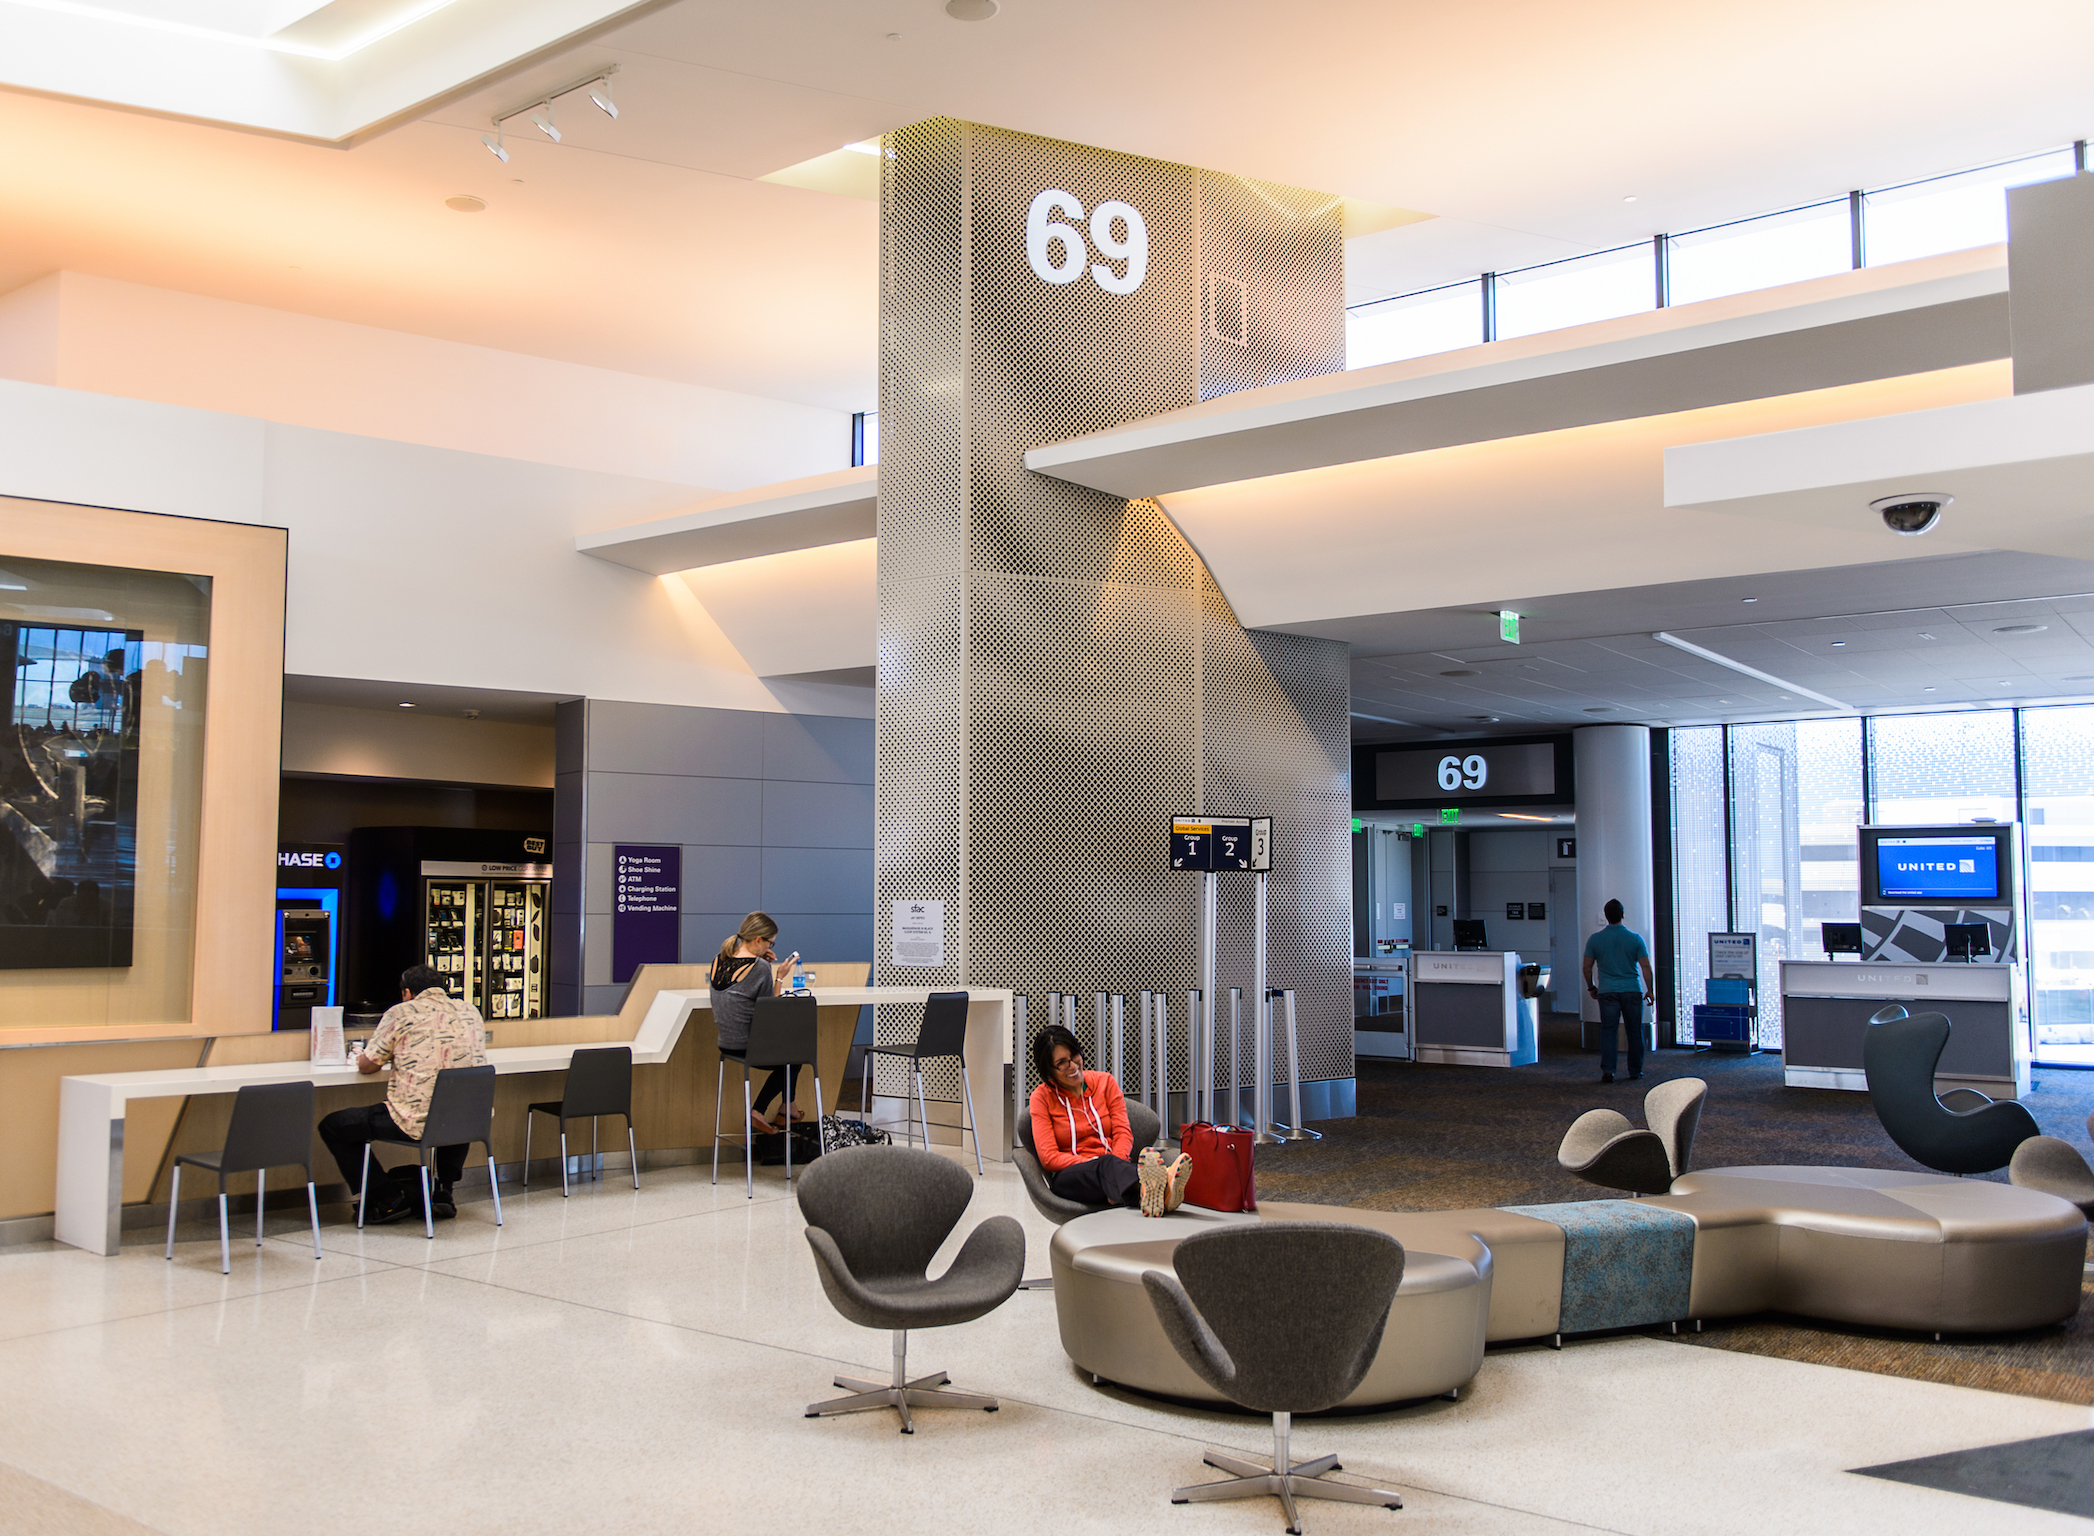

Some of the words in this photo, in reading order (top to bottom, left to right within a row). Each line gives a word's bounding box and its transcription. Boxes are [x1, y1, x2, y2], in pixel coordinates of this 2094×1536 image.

[1026, 189, 1148, 295] 69
[1437, 754, 1487, 791] 69
[1441, 808, 1459, 824] EXIT
[1188, 841, 1197, 856] 1
[1225, 842, 1235, 857] 2
[1257, 838, 1264, 856] 3
[278, 852, 324, 867] HASE
[1897, 862, 1957, 871] UNITED
[627, 885, 654, 893] Charging
[910, 903, 925, 913] sfac
[1857, 974, 1912, 983] UNITED
